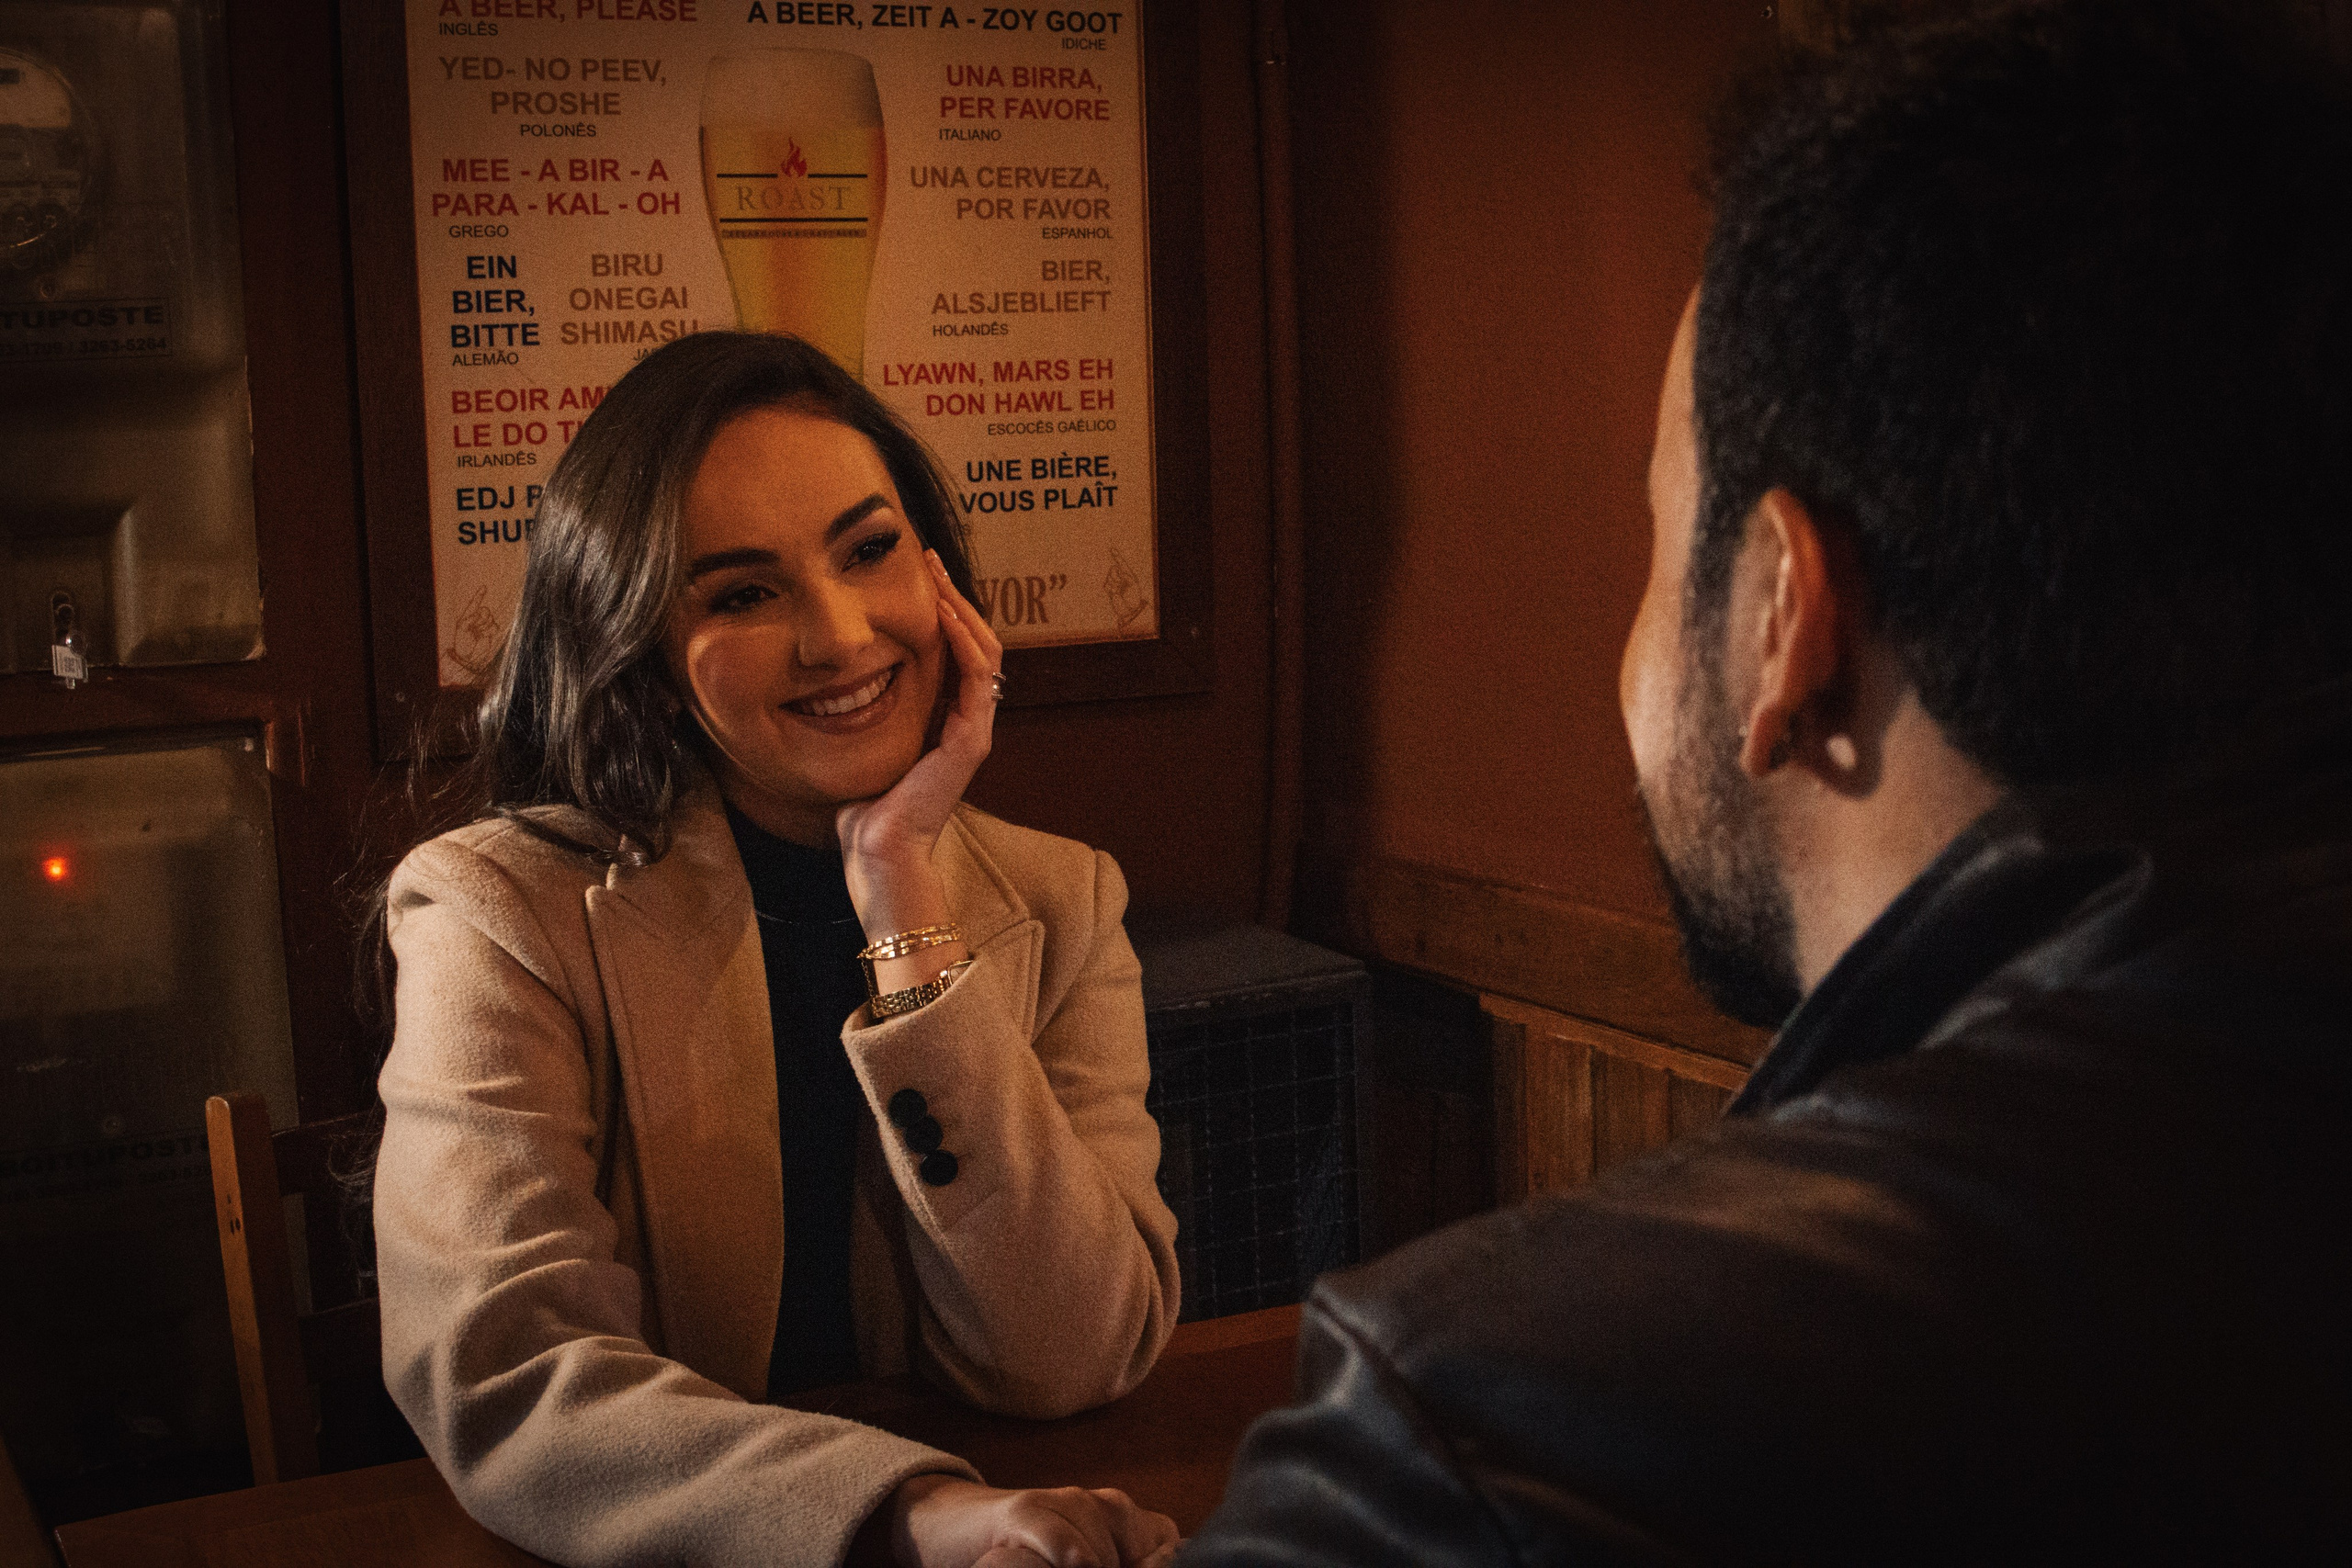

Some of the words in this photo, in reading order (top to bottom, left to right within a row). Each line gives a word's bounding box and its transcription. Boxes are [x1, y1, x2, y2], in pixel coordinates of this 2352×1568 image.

[438, 0, 462, 17] A
[470, 0, 566, 23] BEER,
[577, 0, 698, 22] PLEASE
[746, 1, 769, 24] A
[776, 1, 863, 30] BEER,
[871, 4, 933, 28] ZEIT
[939, 6, 959, 29] A
[982, 7, 1039, 31] ZOY
[1046, 9, 1124, 34] GOOT
[438, 21, 499, 37] INGLÊS
[1061, 38, 1107, 51] IDICHE
[525, 57, 571, 82] NO
[581, 58, 667, 86] PEEV,
[946, 64, 1006, 87] UNA
[1012, 66, 1102, 93] BIRRA,
[491, 92, 622, 116] PROSHE
[940, 96, 997, 119] PER
[1004, 97, 1111, 121] FAVORE
[520, 122, 597, 138] POLONÊS
[938, 129, 1002, 141] ITALIANO
[442, 158, 511, 183] MEE
[537, 159, 561, 183] A
[568, 158, 621, 183] BIR
[647, 159, 670, 183] A
[910, 165, 969, 189] UNA
[976, 166, 1110, 193] CERVEZA,
[432, 192, 520, 218] PARA
[547, 191, 610, 217] KAL
[637, 191, 681, 216] OH
[736, 184, 852, 211] ROAST
[956, 198, 1014, 220] POR
[1023, 198, 1112, 220] FAVOR
[448, 225, 509, 239] GREGO
[1042, 227, 1114, 240] ESPANHOL
[467, 254, 517, 279] EIN
[591, 253, 664, 277] BIRU
[1041, 259, 1111, 285] BIER,
[452, 288, 536, 316] BIER,
[569, 286, 689, 311] ONEGAI
[932, 290, 1112, 315] ALSJEBLIEFT
[450, 323, 540, 348] BITTE
[932, 321, 1009, 337] HOLANDÊS
[452, 350, 519, 367] ALEMÃO
[883, 361, 985, 388] LYAWN,
[993, 358, 1070, 383] MARS
[1079, 357, 1114, 380] EH
[451, 388, 551, 414] BEOIR
[926, 392, 986, 417] DON
[994, 390, 1071, 414] HAWL
[1080, 389, 1114, 412] EH
[453, 423, 492, 448] LE
[503, 422, 548, 446] DO
[987, 420, 1054, 436] ESCOCÊS
[458, 450, 537, 468] IRLANDÊS
[966, 458, 1023, 483] UNE
[1031, 452, 1117, 480] BIÈRE,
[457, 485, 514, 511] EDJ
[959, 489, 1035, 513] VOUS
[1044, 480, 1119, 510] PLAÎT
